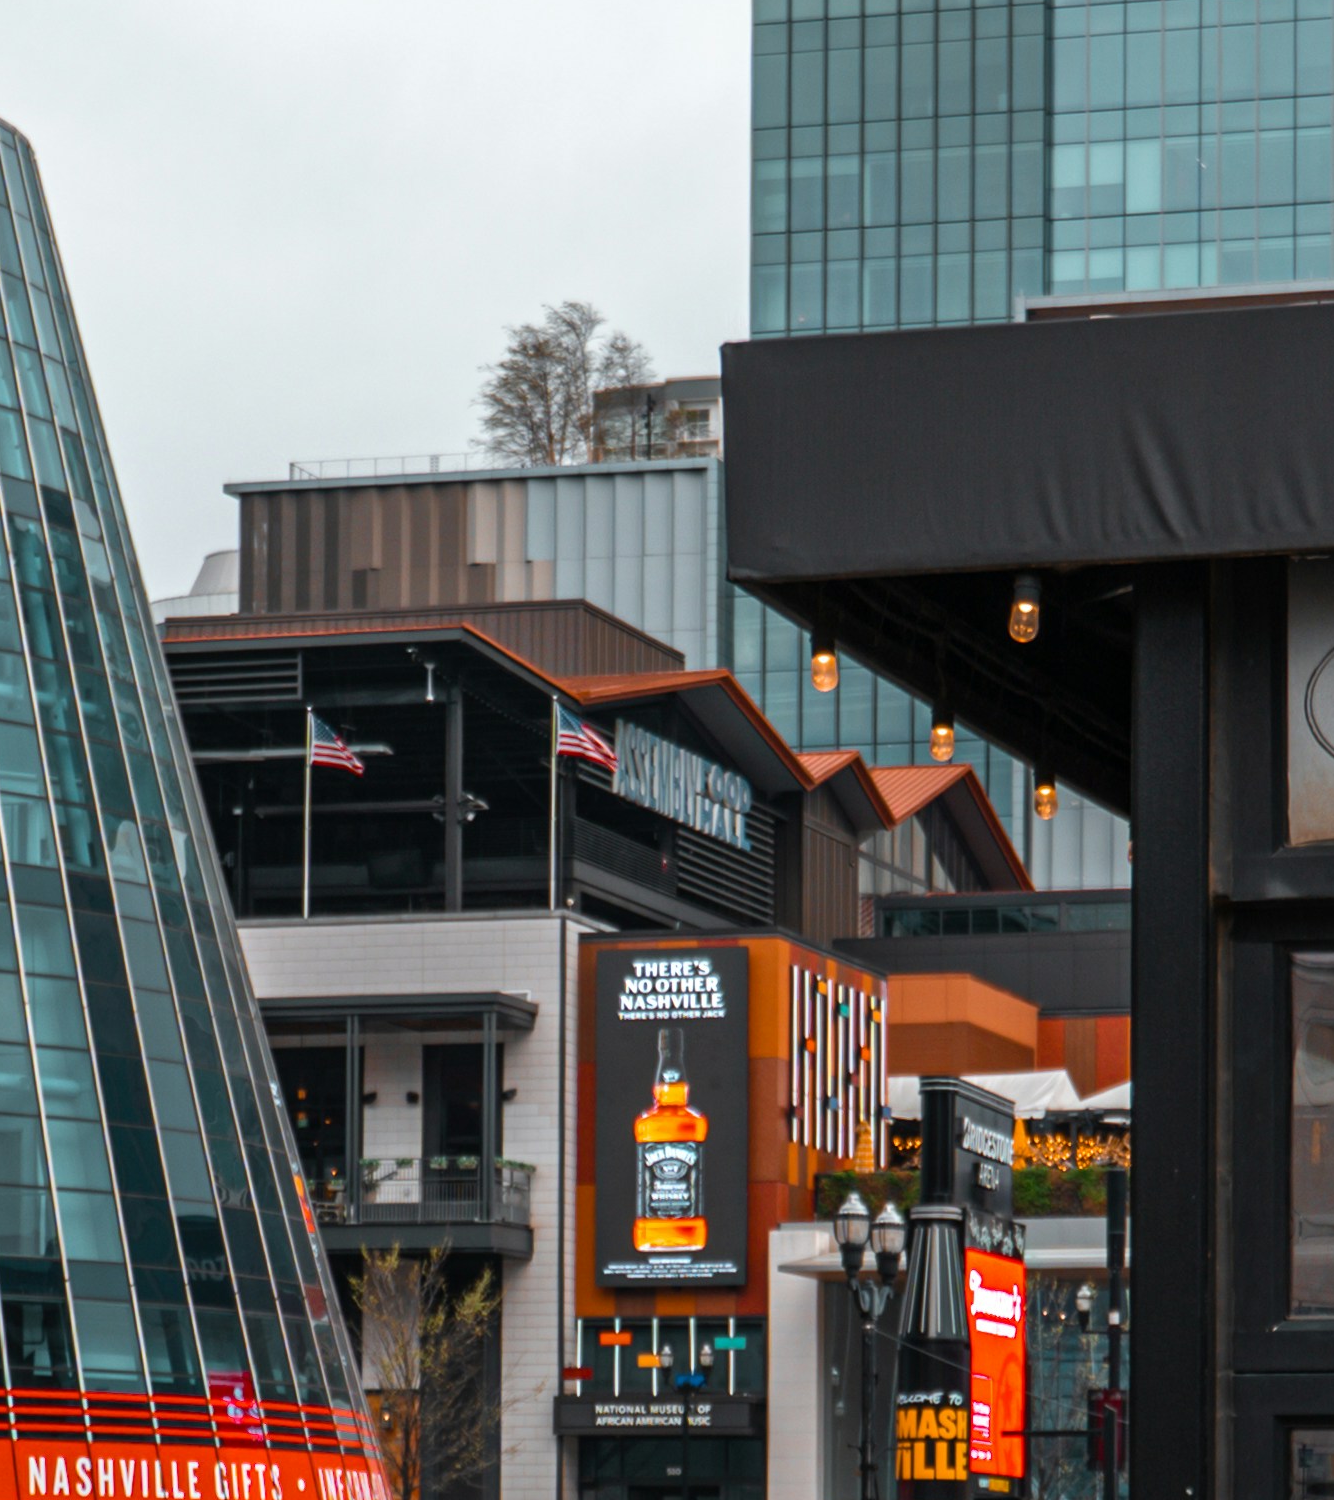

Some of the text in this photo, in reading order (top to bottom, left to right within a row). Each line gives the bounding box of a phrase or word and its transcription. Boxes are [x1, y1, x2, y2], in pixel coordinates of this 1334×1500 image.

[633, 960, 710, 977] THERE'S
[625, 976, 719, 994] NO OTHER
[620, 993, 724, 1011] NASHVILLE
[656, 1011, 669, 1020] NO
[671, 1010, 701, 1020] OTHER
[702, 1009, 726, 1019] JACK
[949, 1392, 963, 1406] TO
[595, 1404, 647, 1414] NATIONAL
[697, 1404, 712, 1414] OF
[595, 1416, 634, 1427] AFRICAN
[635, 1416, 682, 1427] AMERICAN
[897, 1408, 967, 1440] MASH
[28, 1456, 202, 1500] NASHVILLE
